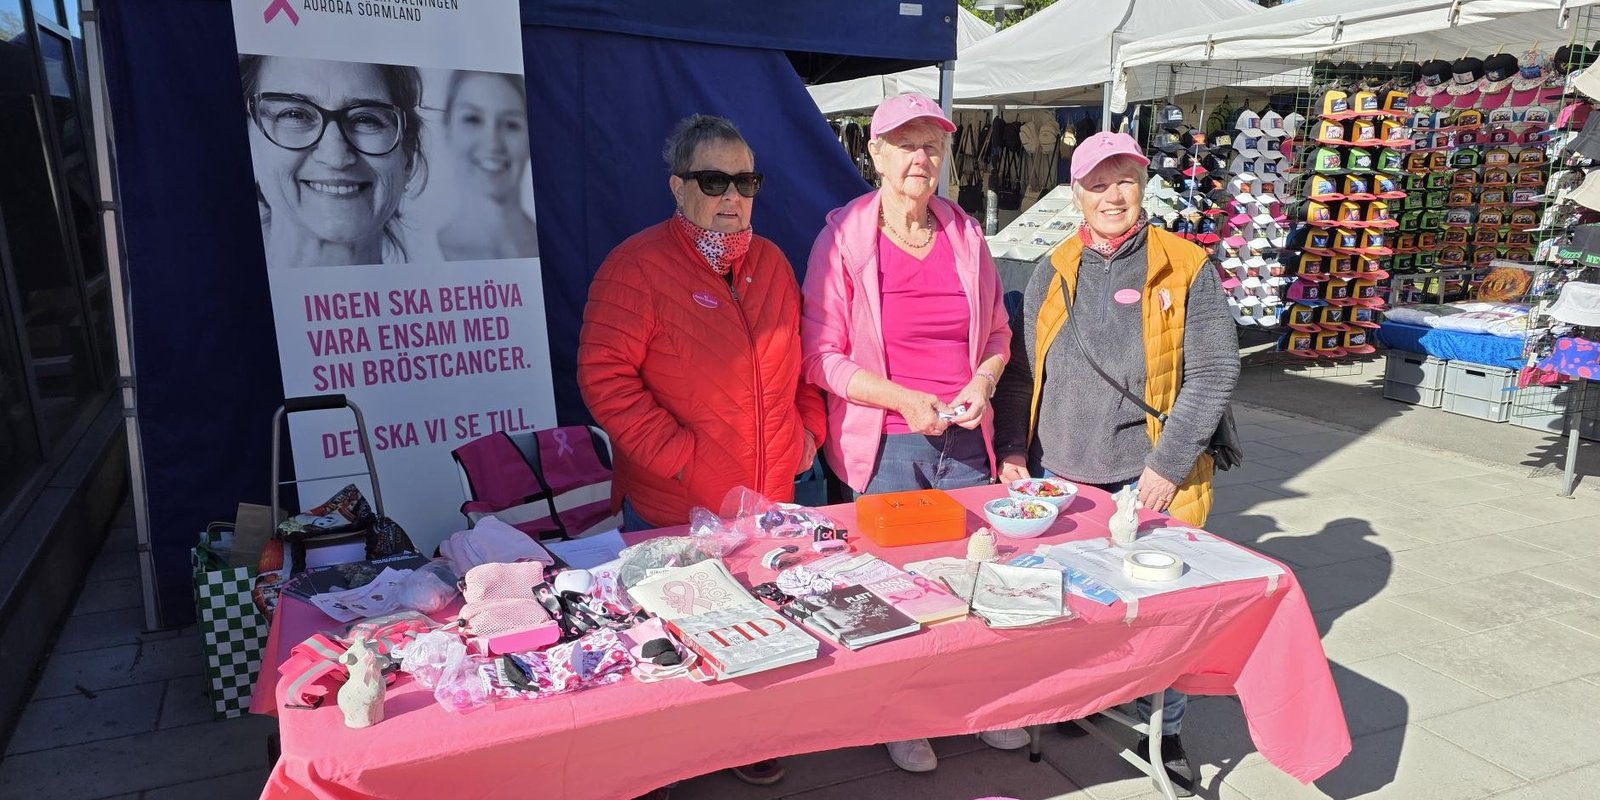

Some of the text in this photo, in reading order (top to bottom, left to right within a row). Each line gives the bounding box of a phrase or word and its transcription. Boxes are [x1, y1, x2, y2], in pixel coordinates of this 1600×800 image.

[303, 0, 422, 22] AURORA SÖRMLAND
[304, 280, 523, 322] INGEN SKA BEHÖVA
[307, 316, 510, 357] VARA ENSAM MED
[313, 346, 532, 391] SIN BRÖSTCANCER.
[322, 407, 535, 459] DET SKA VI SE TILL.
[844, 592, 873, 604] PLATT
